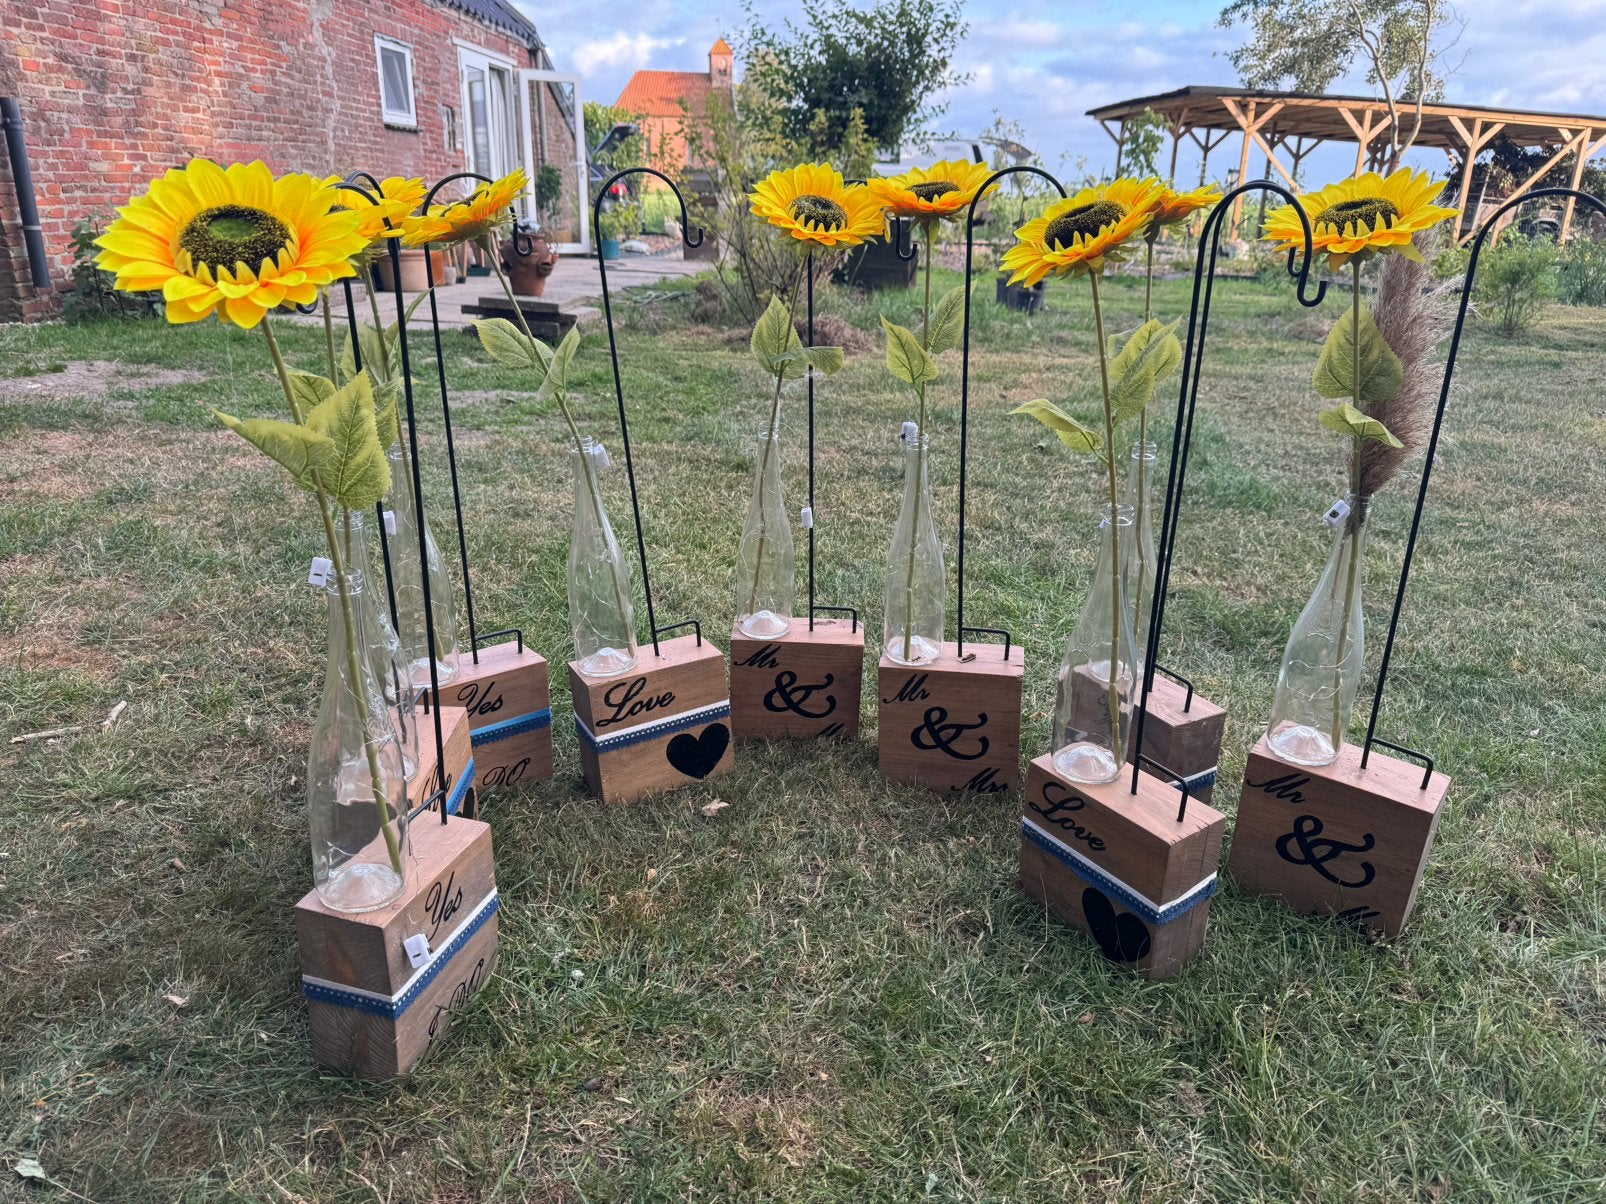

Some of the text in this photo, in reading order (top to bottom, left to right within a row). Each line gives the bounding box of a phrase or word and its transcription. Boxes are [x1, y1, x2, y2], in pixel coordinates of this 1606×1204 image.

[734, 643, 781, 668] Mr
[457, 681, 504, 719] Yes
[595, 676, 676, 727] Love
[763, 671, 837, 719] &
[883, 673, 930, 704] Mr
[910, 706, 990, 761] &
[1246, 773, 1311, 804] Mr
[1028, 781, 1107, 852] Love
[1275, 814, 1376, 888] &
[424, 870, 463, 943] Yes
